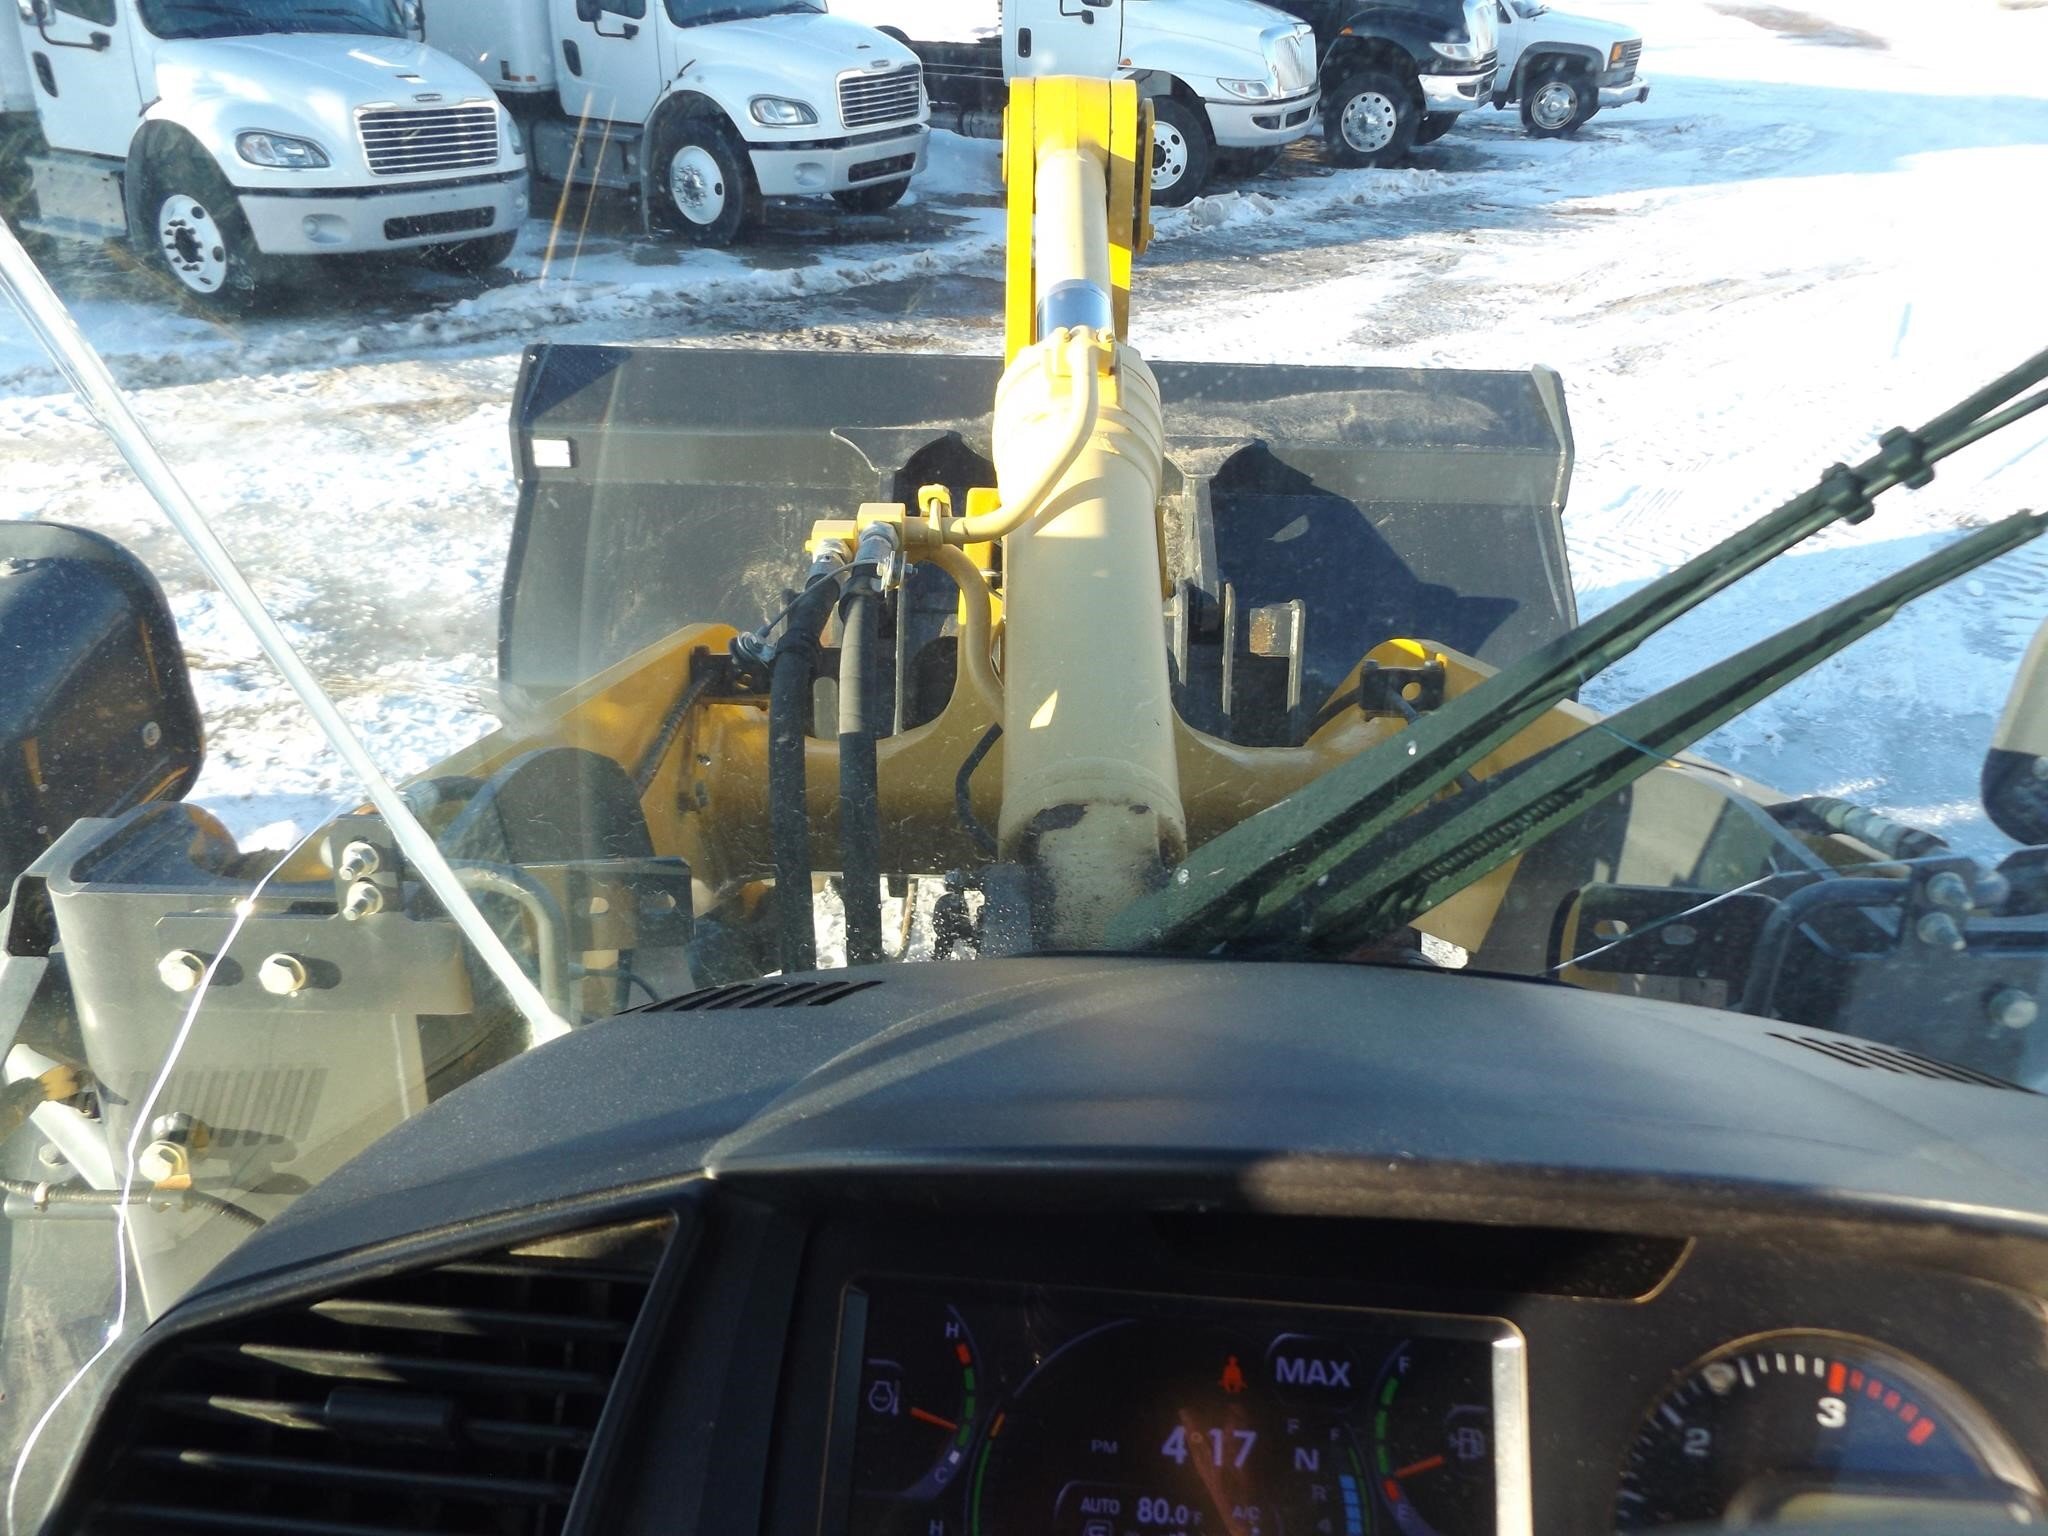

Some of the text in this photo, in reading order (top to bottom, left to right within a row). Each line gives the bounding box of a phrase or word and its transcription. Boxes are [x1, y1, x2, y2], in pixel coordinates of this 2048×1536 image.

[944, 1321, 959, 1338] H
[1275, 1356, 1351, 1388] MAX
[1398, 1356, 1410, 1374] F
[1816, 1396, 1847, 1429] 3
[1286, 1418, 1299, 1434] F
[1091, 1439, 1118, 1455] PM
[1683, 1427, 1711, 1457] 2
[1294, 1446, 1320, 1472] N
[1080, 1496, 1121, 1515] AUTO
[1232, 1504, 1263, 1521] A/C
